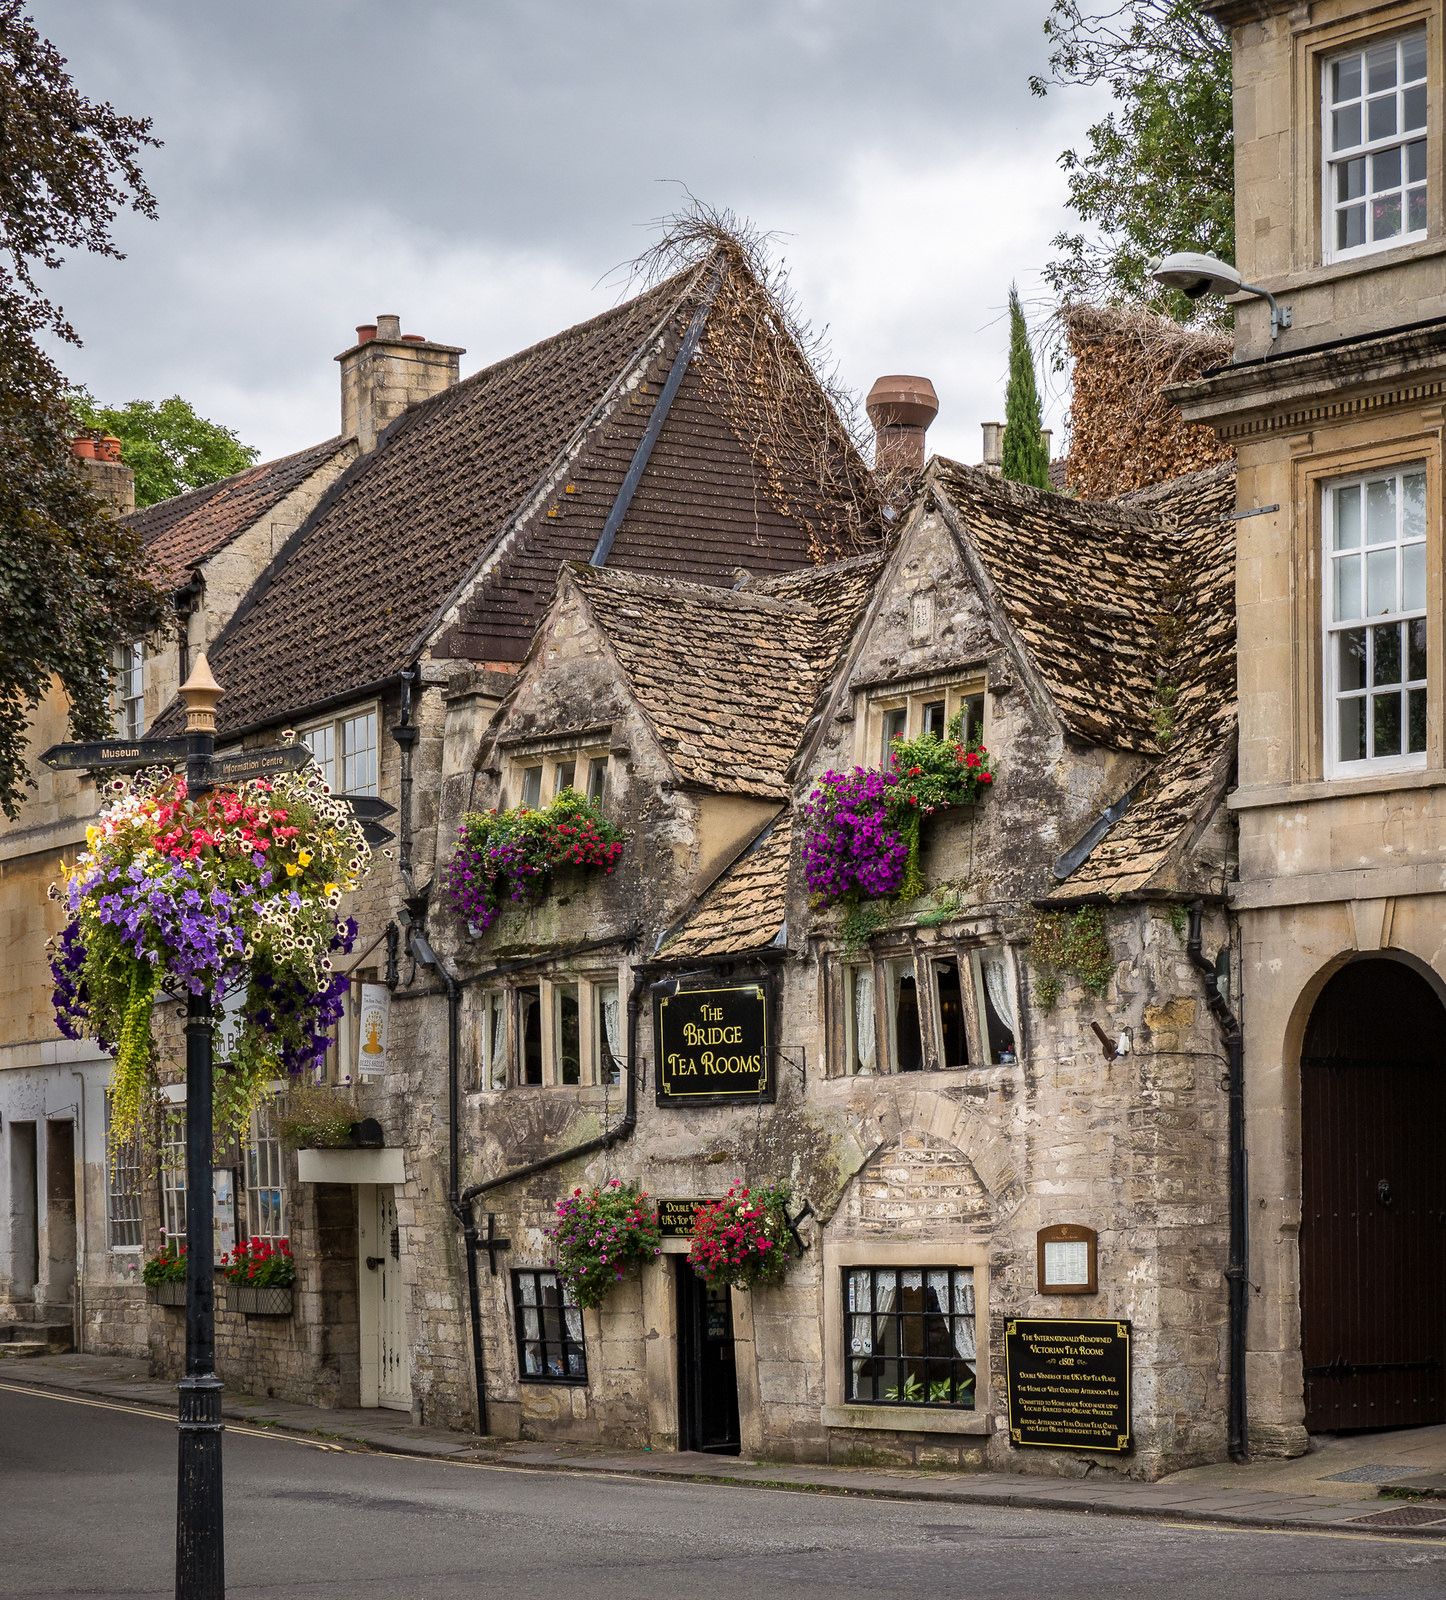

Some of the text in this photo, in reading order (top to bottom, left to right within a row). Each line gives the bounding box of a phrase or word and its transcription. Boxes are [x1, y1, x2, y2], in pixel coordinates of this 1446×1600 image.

[102, 748, 139, 758] Museum
[222, 756, 284, 774] Information Centre
[700, 1004, 723, 1022] THE
[683, 1022, 743, 1046] BRIDGE
[668, 1051, 760, 1076] TEA ROOMS
[666, 1202, 690, 1212] DOUBLE
[708, 1328, 724, 1336] OPEN
[1030, 1344, 1104, 1355] VICTORIAN TEA ROOMS
